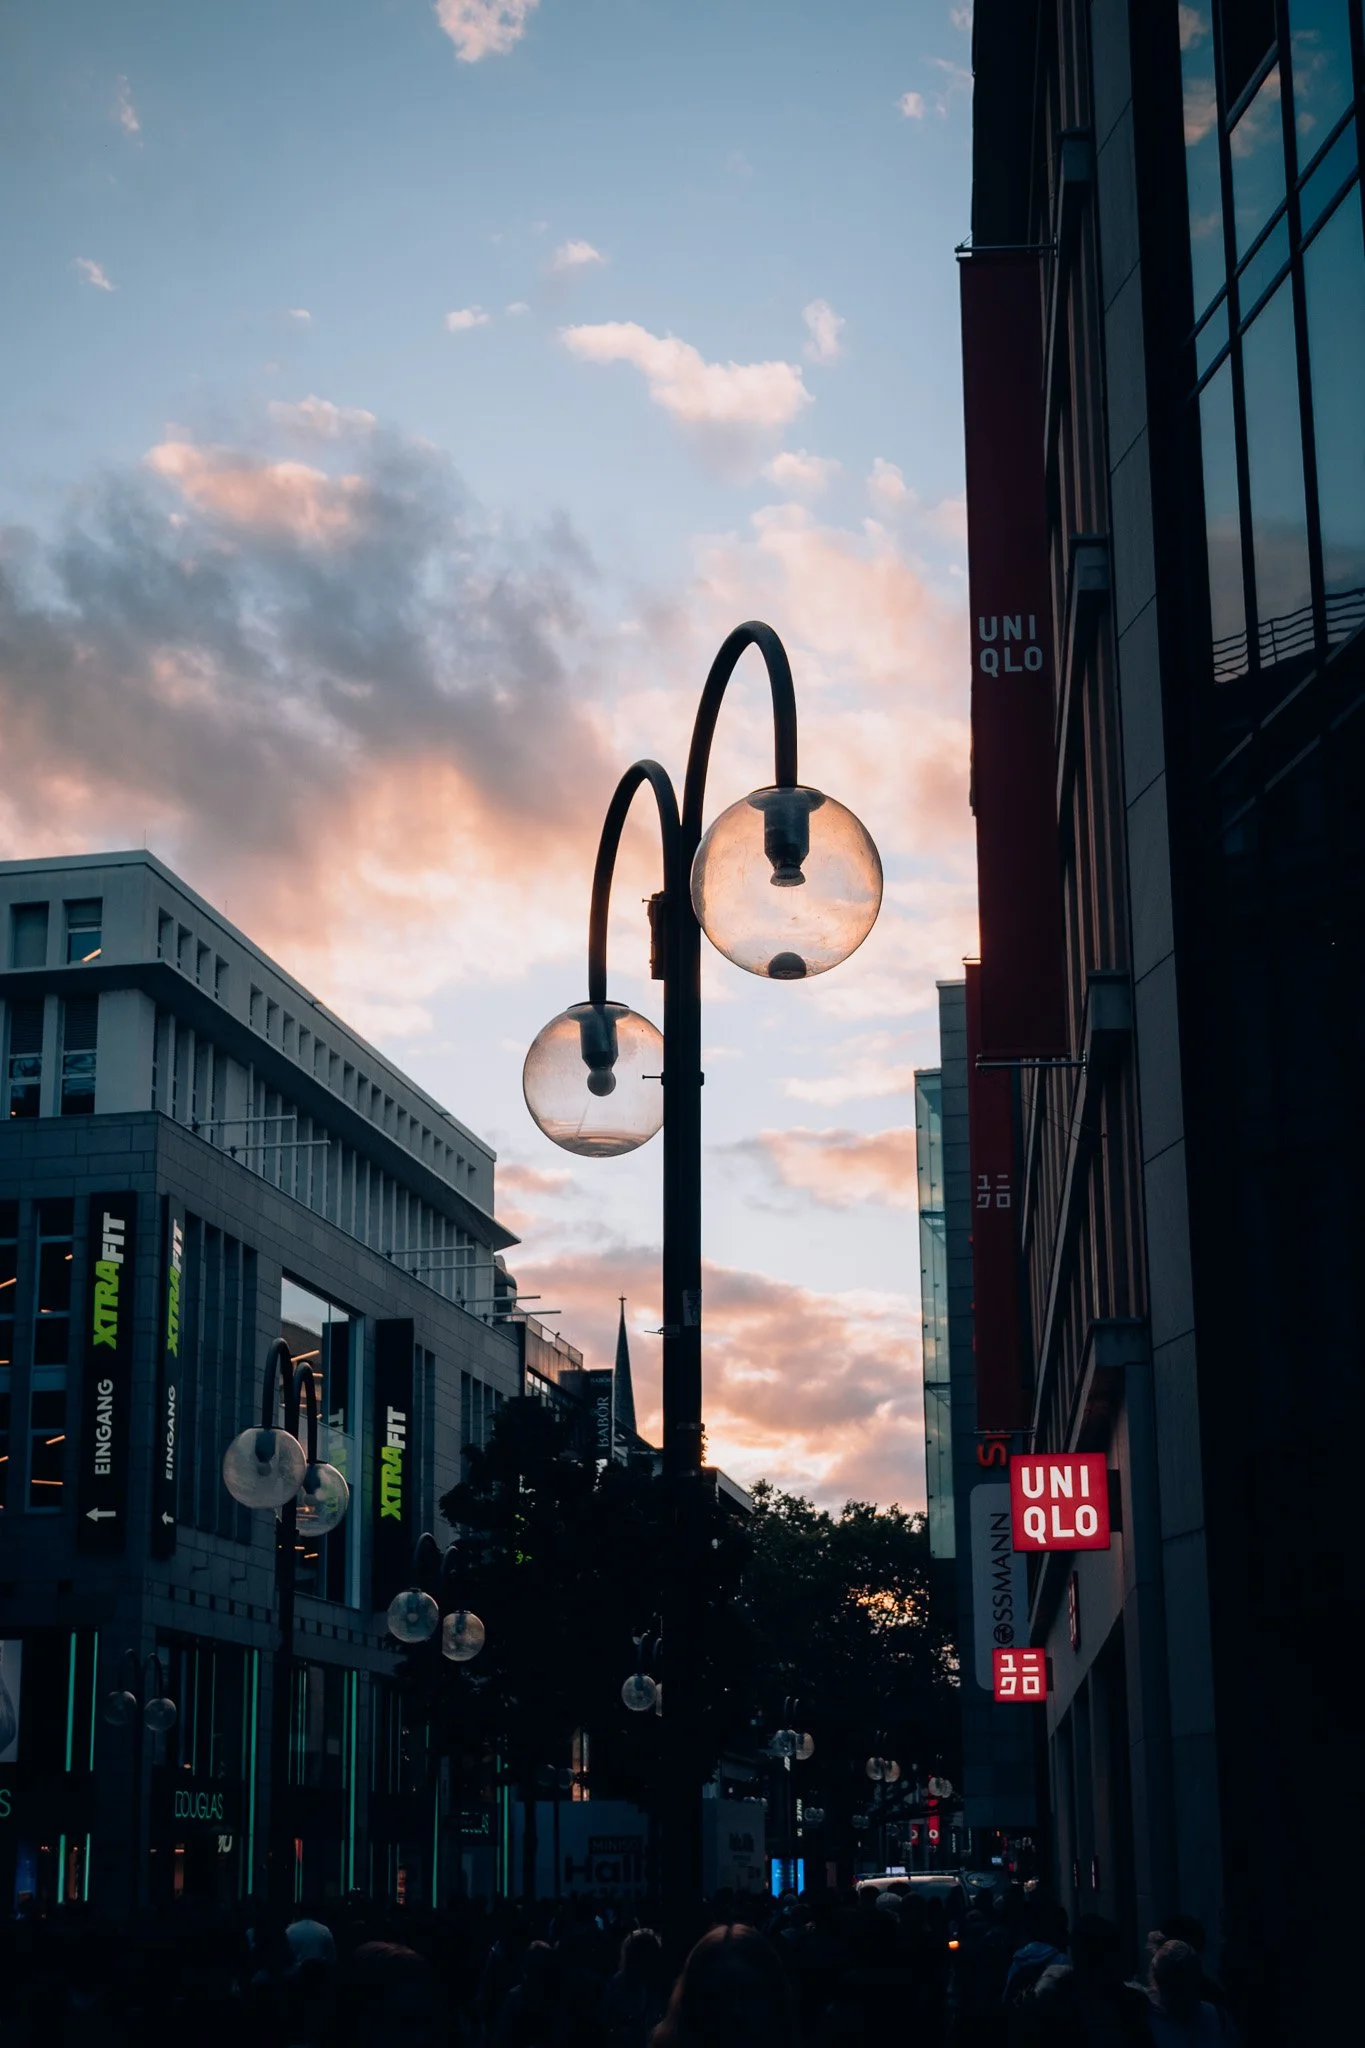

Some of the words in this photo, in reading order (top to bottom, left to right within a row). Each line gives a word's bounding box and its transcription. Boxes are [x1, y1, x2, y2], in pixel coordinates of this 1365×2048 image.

[978, 614, 1036, 641] UNI
[979, 646, 1043, 678] QLO
[92, 1211, 126, 1351] XTRAFIT
[94, 1378, 114, 1476] EINGANG
[165, 1384, 176, 1481] EINGANG
[596, 1395, 609, 1448] BABOR
[380, 1405, 406, 1522] XTRAFIT
[1021, 1465, 1090, 1499] UNI
[1023, 1504, 1098, 1544] QLO
[990, 1513, 1014, 1649] OSSMANN
[174, 1790, 224, 1820] DOUGLAS
